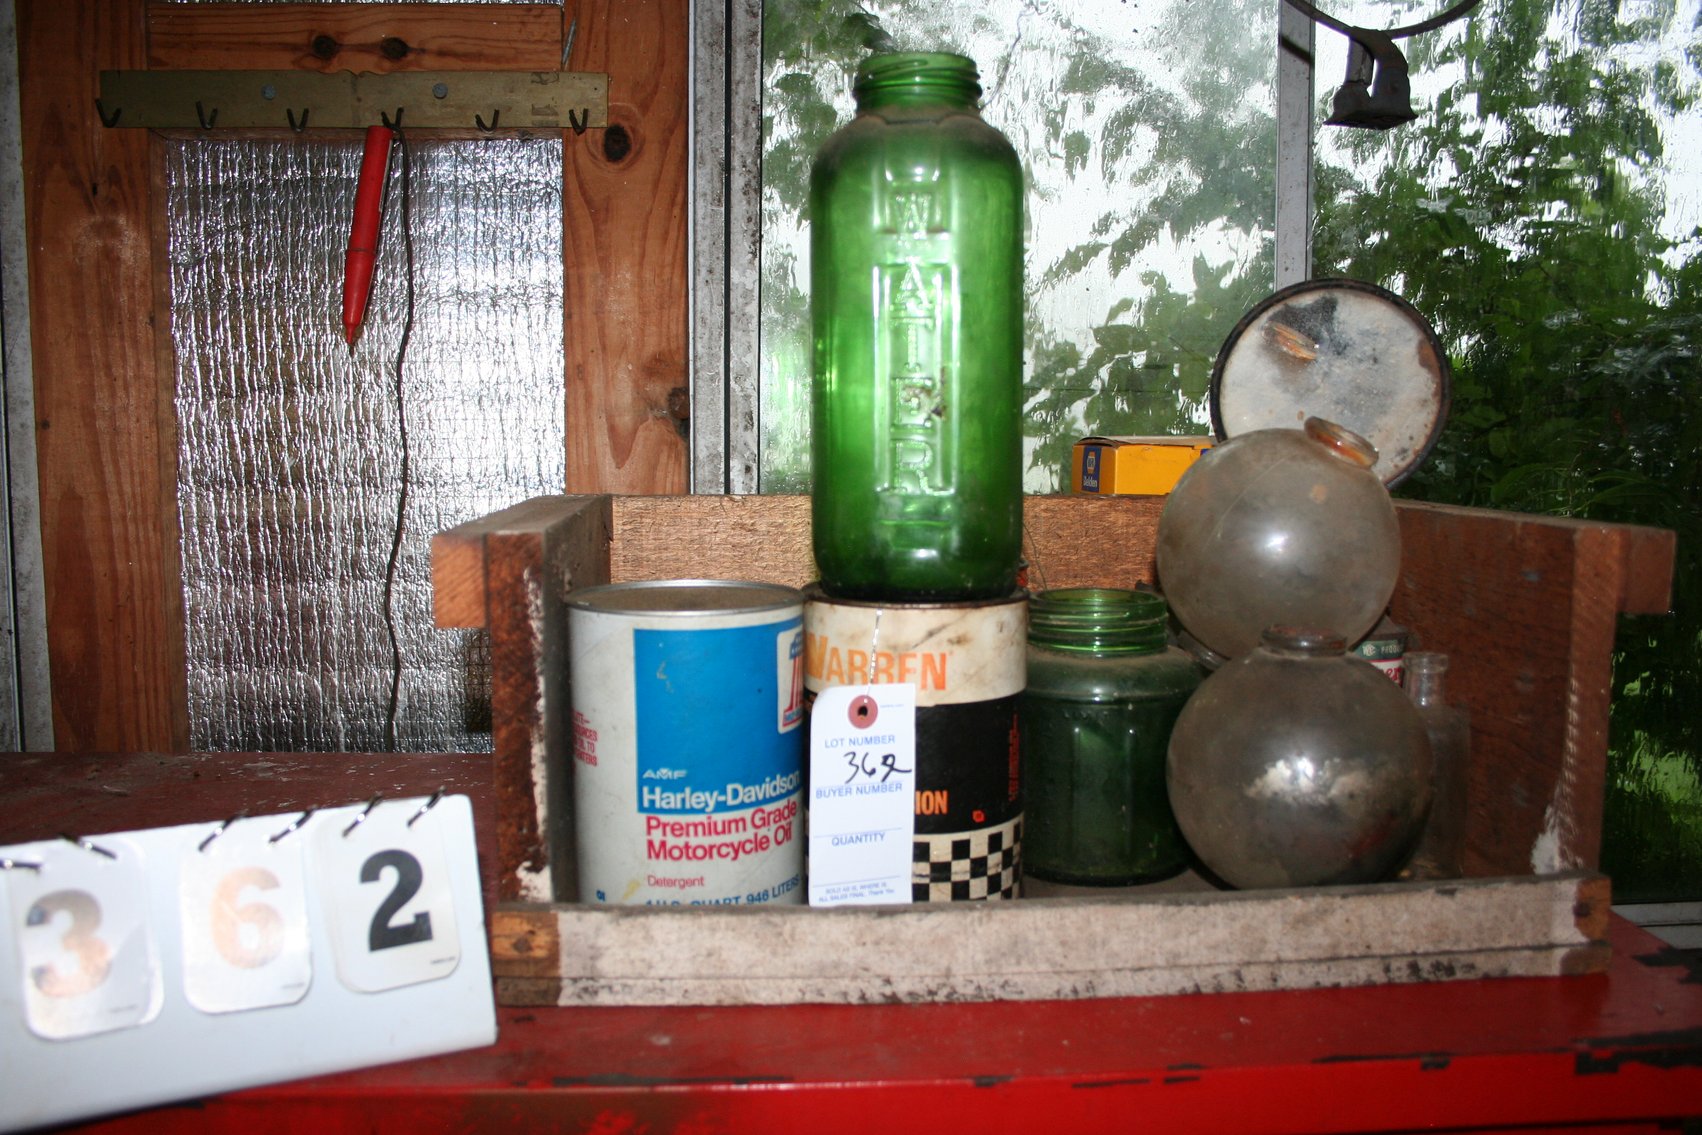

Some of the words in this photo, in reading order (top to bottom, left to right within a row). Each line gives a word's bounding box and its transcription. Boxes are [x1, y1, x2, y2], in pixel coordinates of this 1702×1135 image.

[890, 192, 948, 496] WATER
[805, 631, 947, 691] WARREN
[824, 738, 845, 749] LOT
[848, 735, 896, 747] NUMBER
[642, 768, 687, 780] AMF
[843, 751, 912, 784] 362
[642, 769, 801, 813] Harley-Davidson
[815, 786, 852, 799] BUYER
[855, 783, 903, 796] NUMBER
[646, 815, 747, 838] Premium
[751, 799, 797, 830] Grade
[646, 833, 770, 861] Motorcycle
[774, 822, 793, 846] Oil
[831, 832, 886, 846] QUANTITY
[647, 875, 705, 890] Detergent
[211, 865, 285, 970] 6
[359, 848, 435, 952] 2
